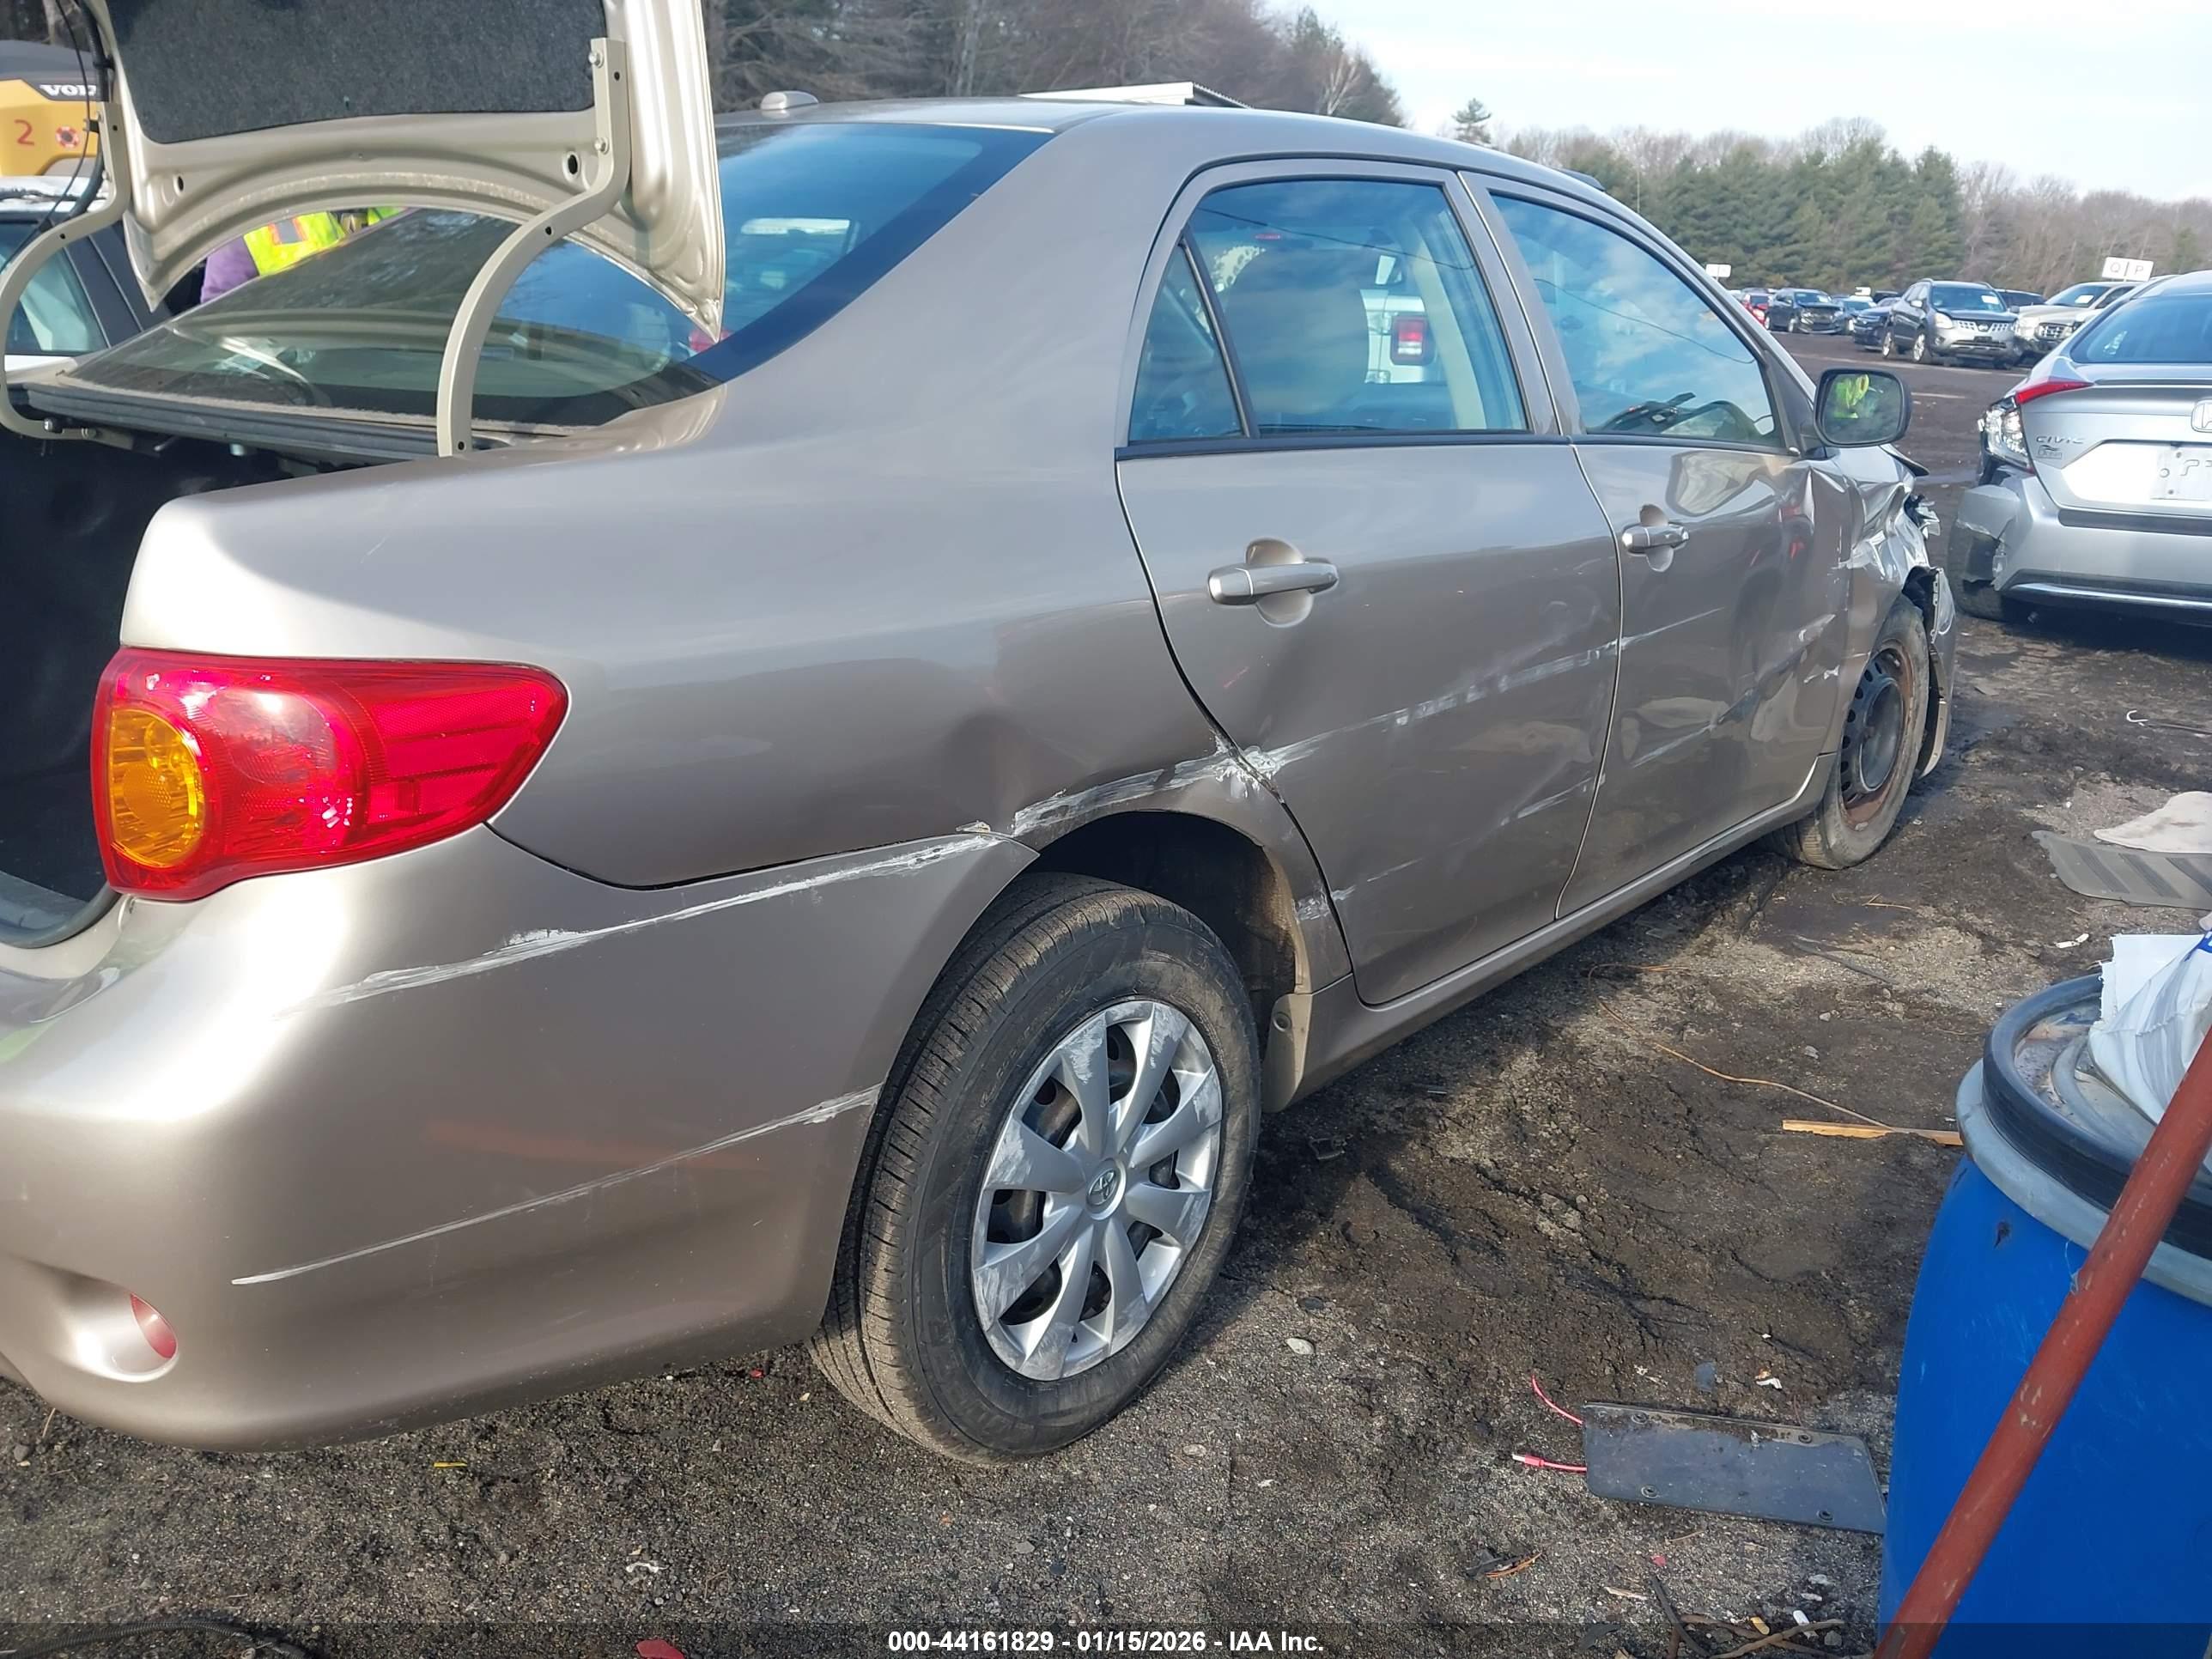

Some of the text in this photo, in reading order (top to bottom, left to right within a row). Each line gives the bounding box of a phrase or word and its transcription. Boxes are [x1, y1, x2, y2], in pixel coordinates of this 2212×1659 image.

[39, 83, 97, 97] VOL
[14, 118, 35, 146] 2
[2036, 435, 2085, 445] CIVIC
